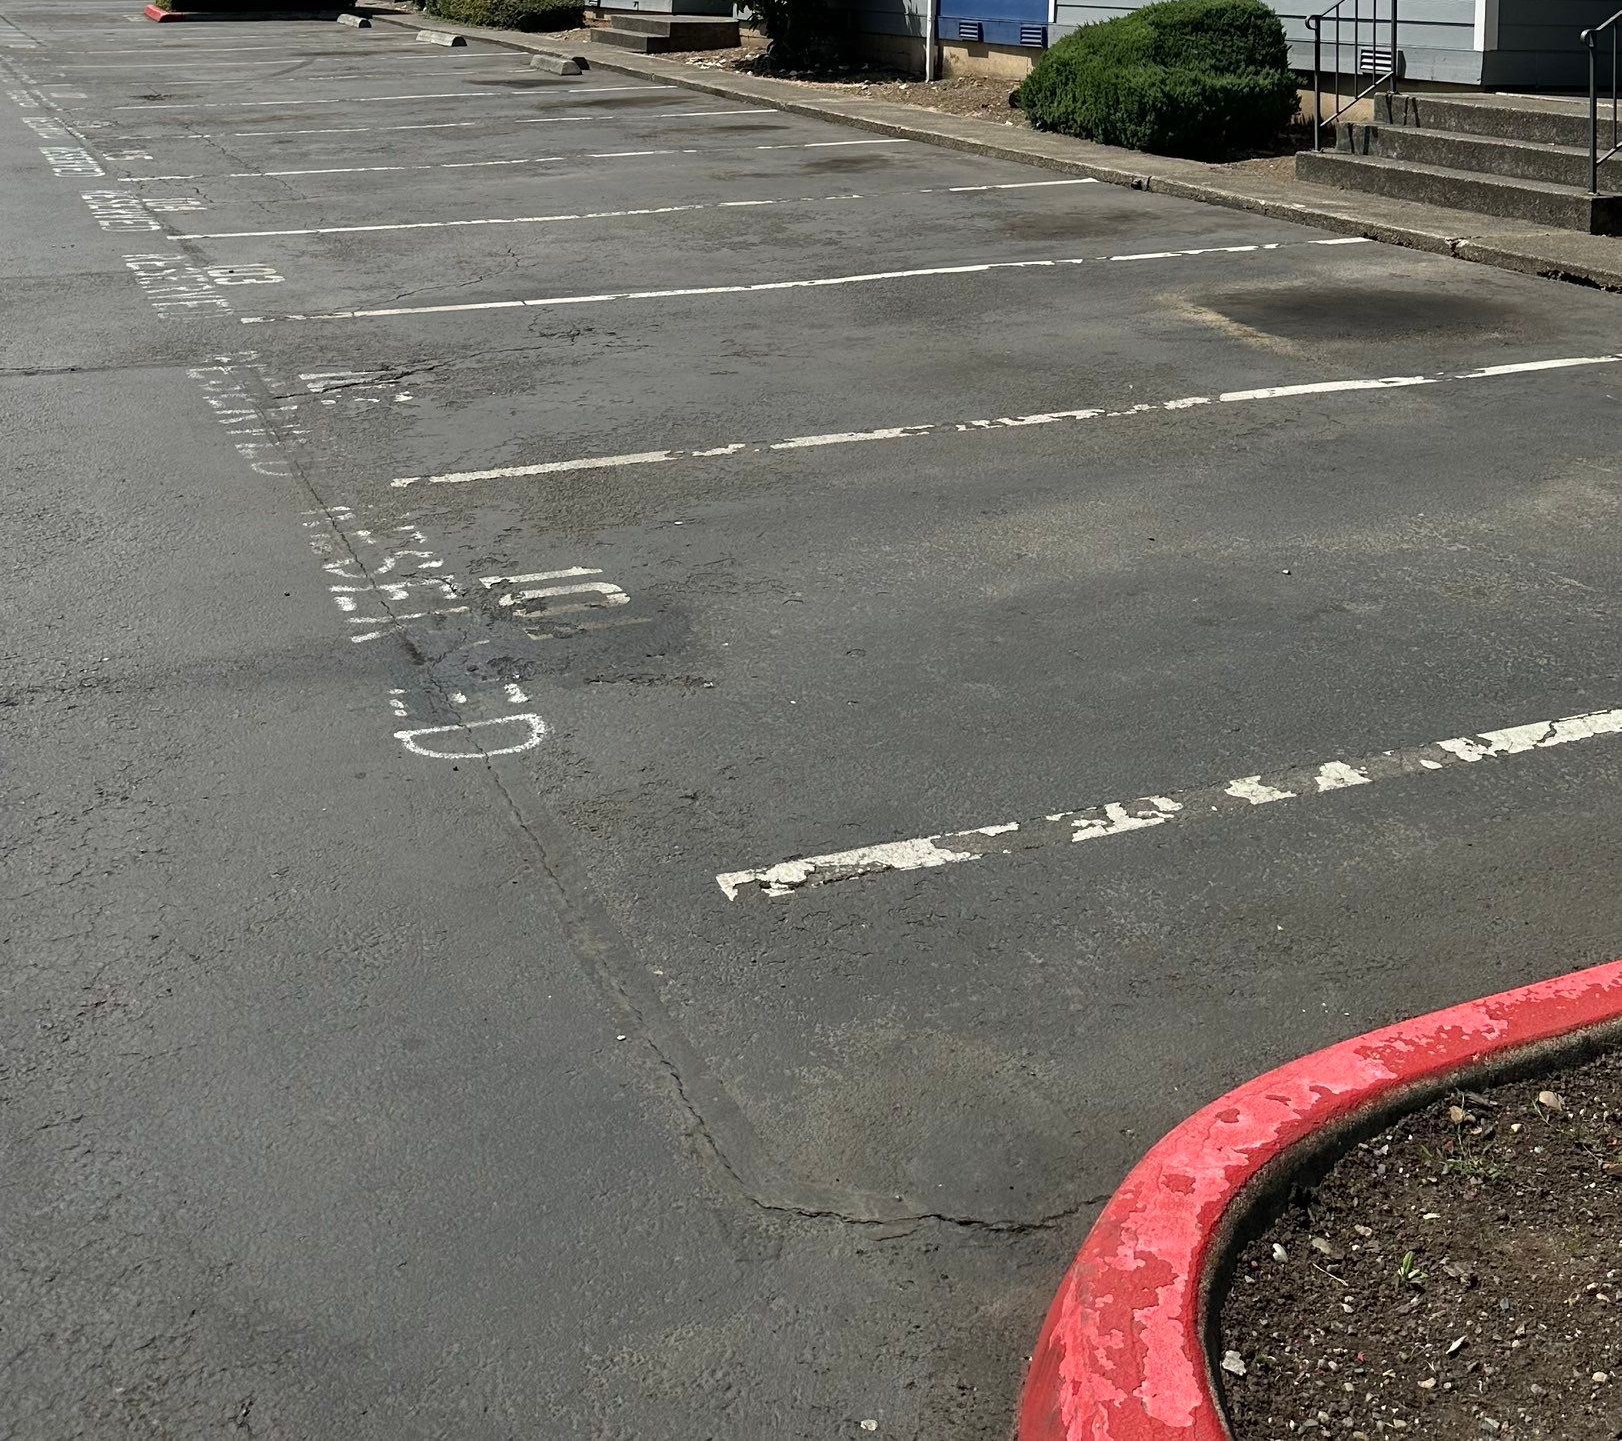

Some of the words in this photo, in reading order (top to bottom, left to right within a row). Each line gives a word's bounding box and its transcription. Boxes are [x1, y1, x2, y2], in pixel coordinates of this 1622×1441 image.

[80, 190, 161, 232] RESERVED
[121, 254, 234, 319] RESERVED
[202, 263, 286, 285] 103
